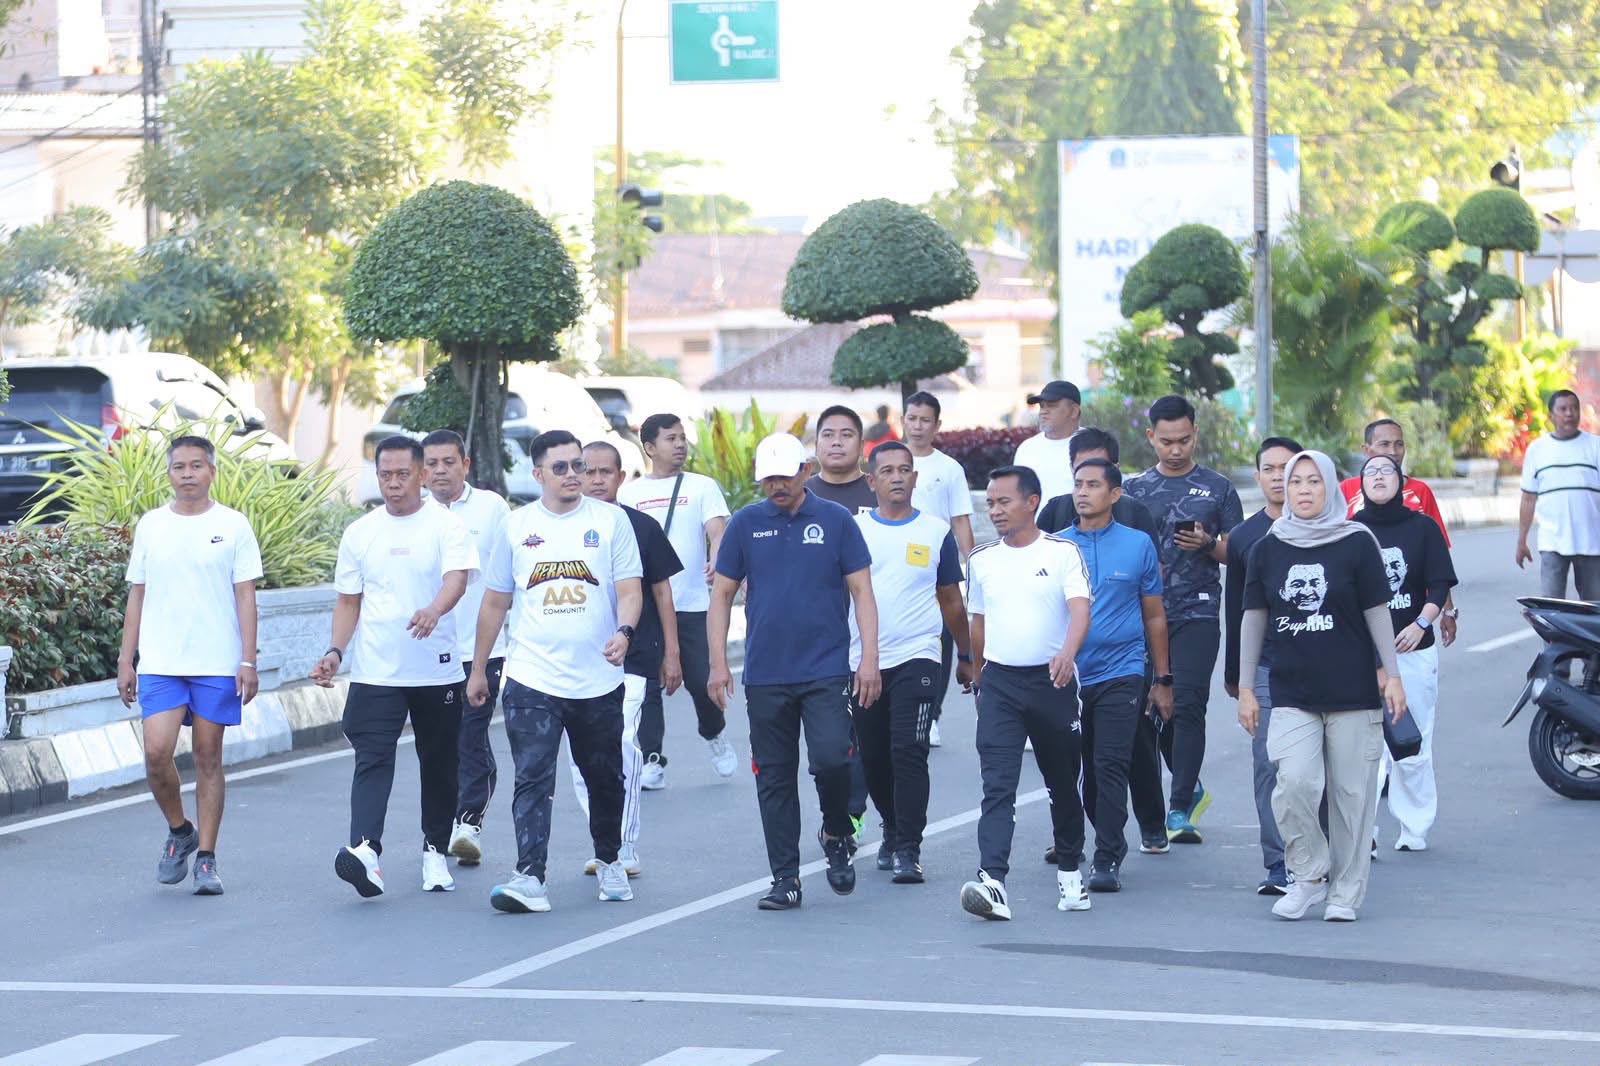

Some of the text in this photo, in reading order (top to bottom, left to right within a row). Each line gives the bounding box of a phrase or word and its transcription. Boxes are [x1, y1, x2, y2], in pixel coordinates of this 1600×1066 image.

[1076, 238, 1138, 257] HARI
[753, 530, 773, 538] KOMISI
[543, 584, 587, 606] AAS
[543, 606, 586, 615] COMMUNITY
